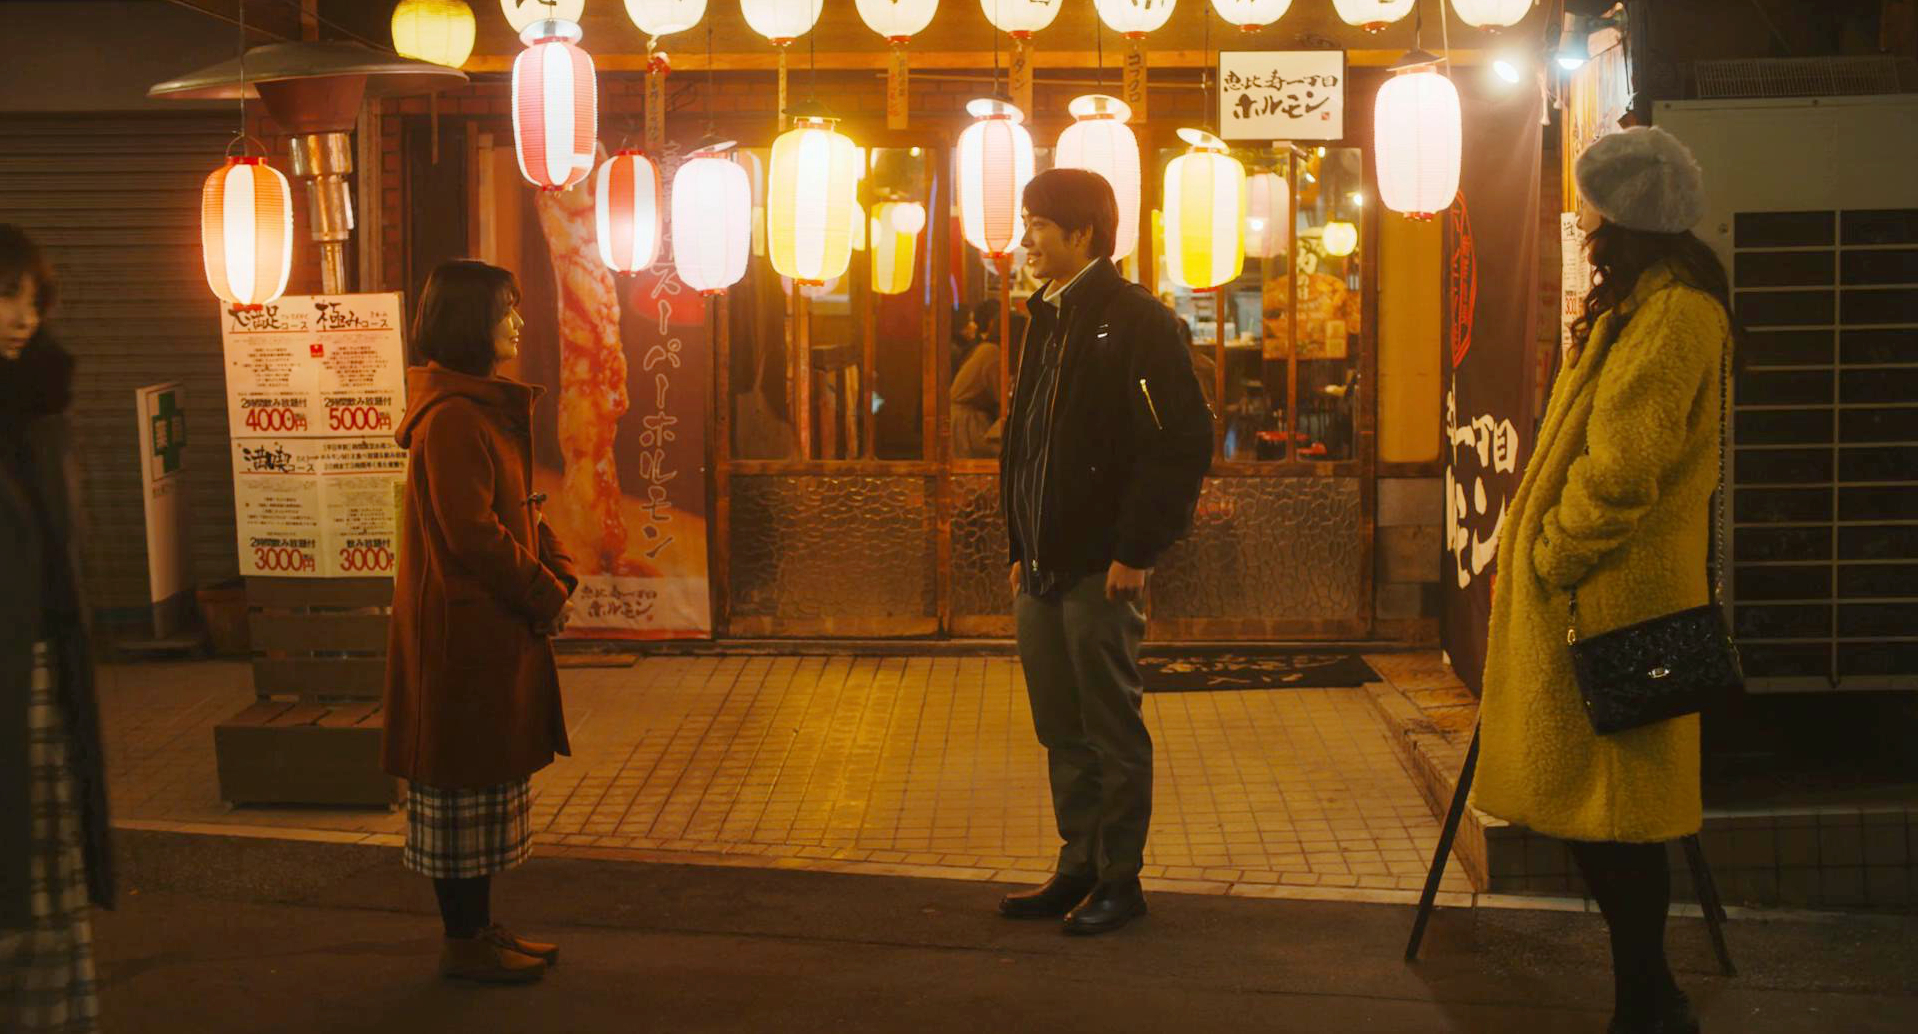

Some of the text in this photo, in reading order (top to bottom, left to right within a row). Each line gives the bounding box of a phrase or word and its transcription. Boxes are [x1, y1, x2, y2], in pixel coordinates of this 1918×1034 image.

[1223, 69, 1339, 92] 恵比寿一丁目
[1233, 91, 1330, 119] ホルモン
[245, 408, 308, 432] 4000円
[329, 407, 392, 431] 5000円
[254, 548, 316, 572] 3000円
[588, 601, 654, 619] ホルモン
